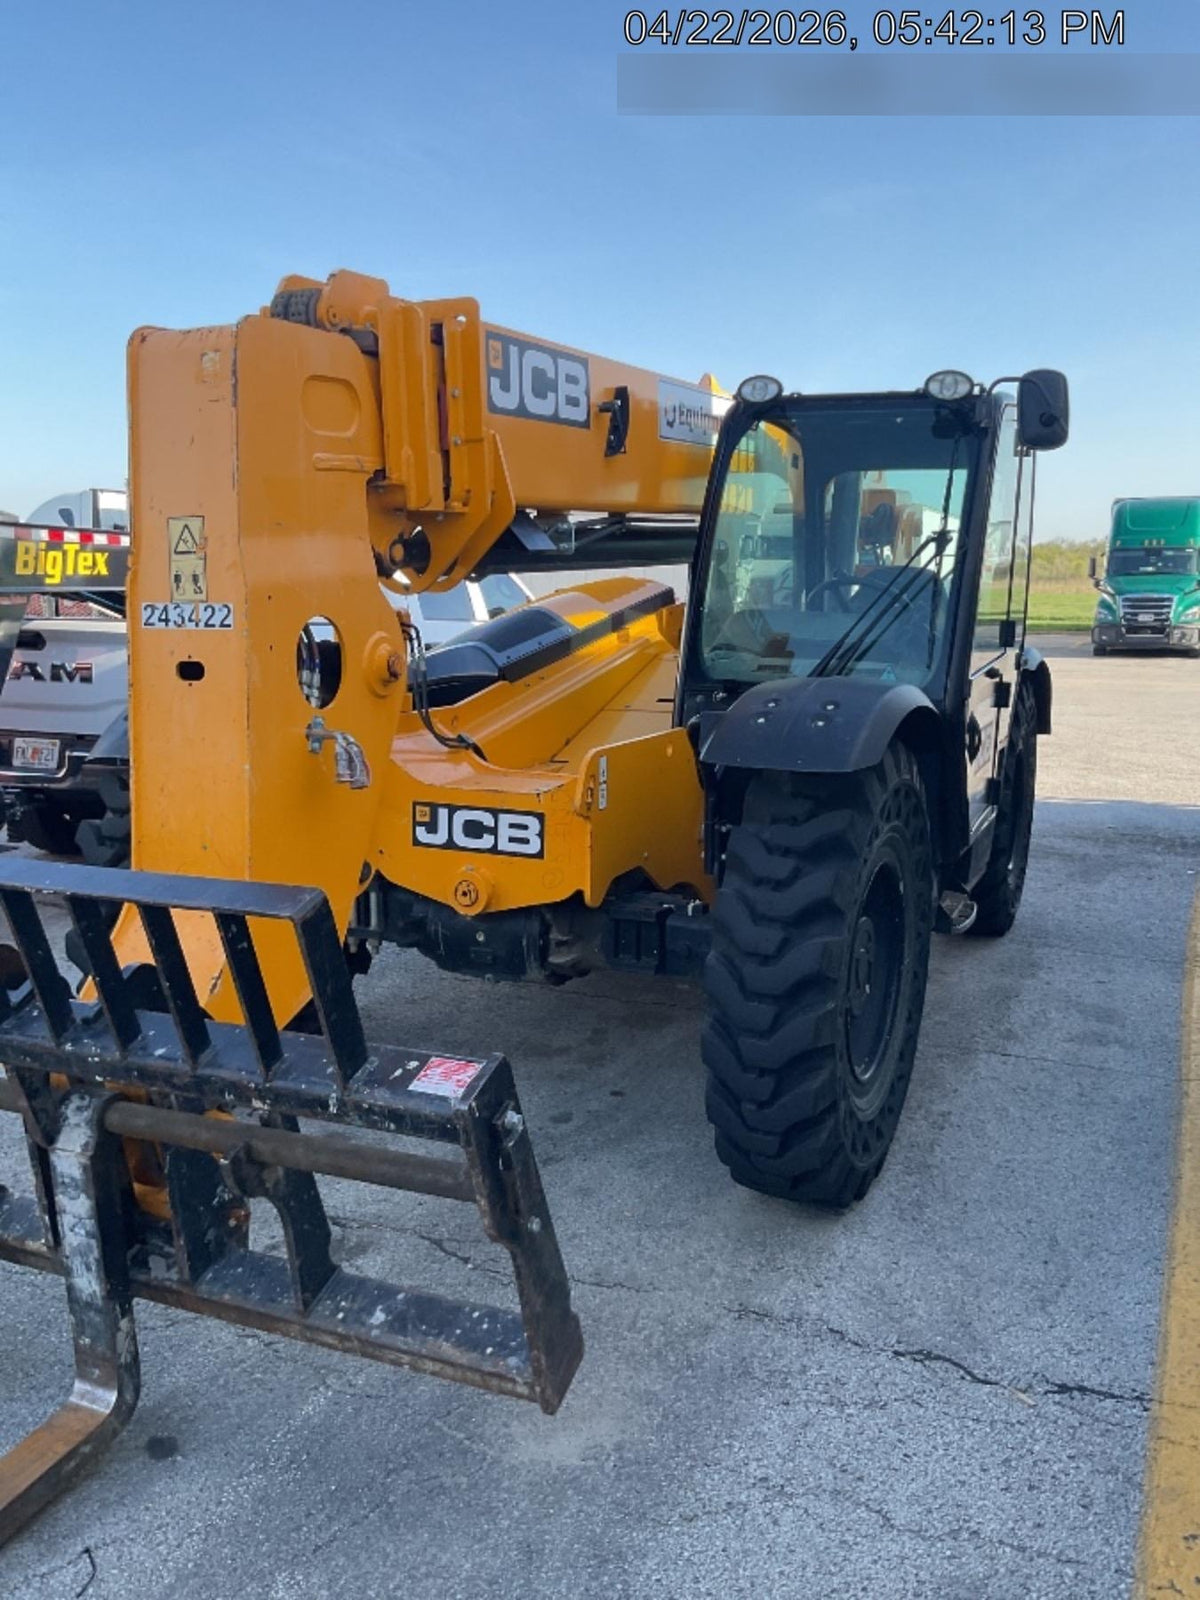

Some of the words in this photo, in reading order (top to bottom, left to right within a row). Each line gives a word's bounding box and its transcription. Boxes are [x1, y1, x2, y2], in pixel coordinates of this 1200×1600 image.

[490, 344, 588, 422] JCB
[143, 604, 232, 628] 243422
[415, 806, 541, 854] JCB
